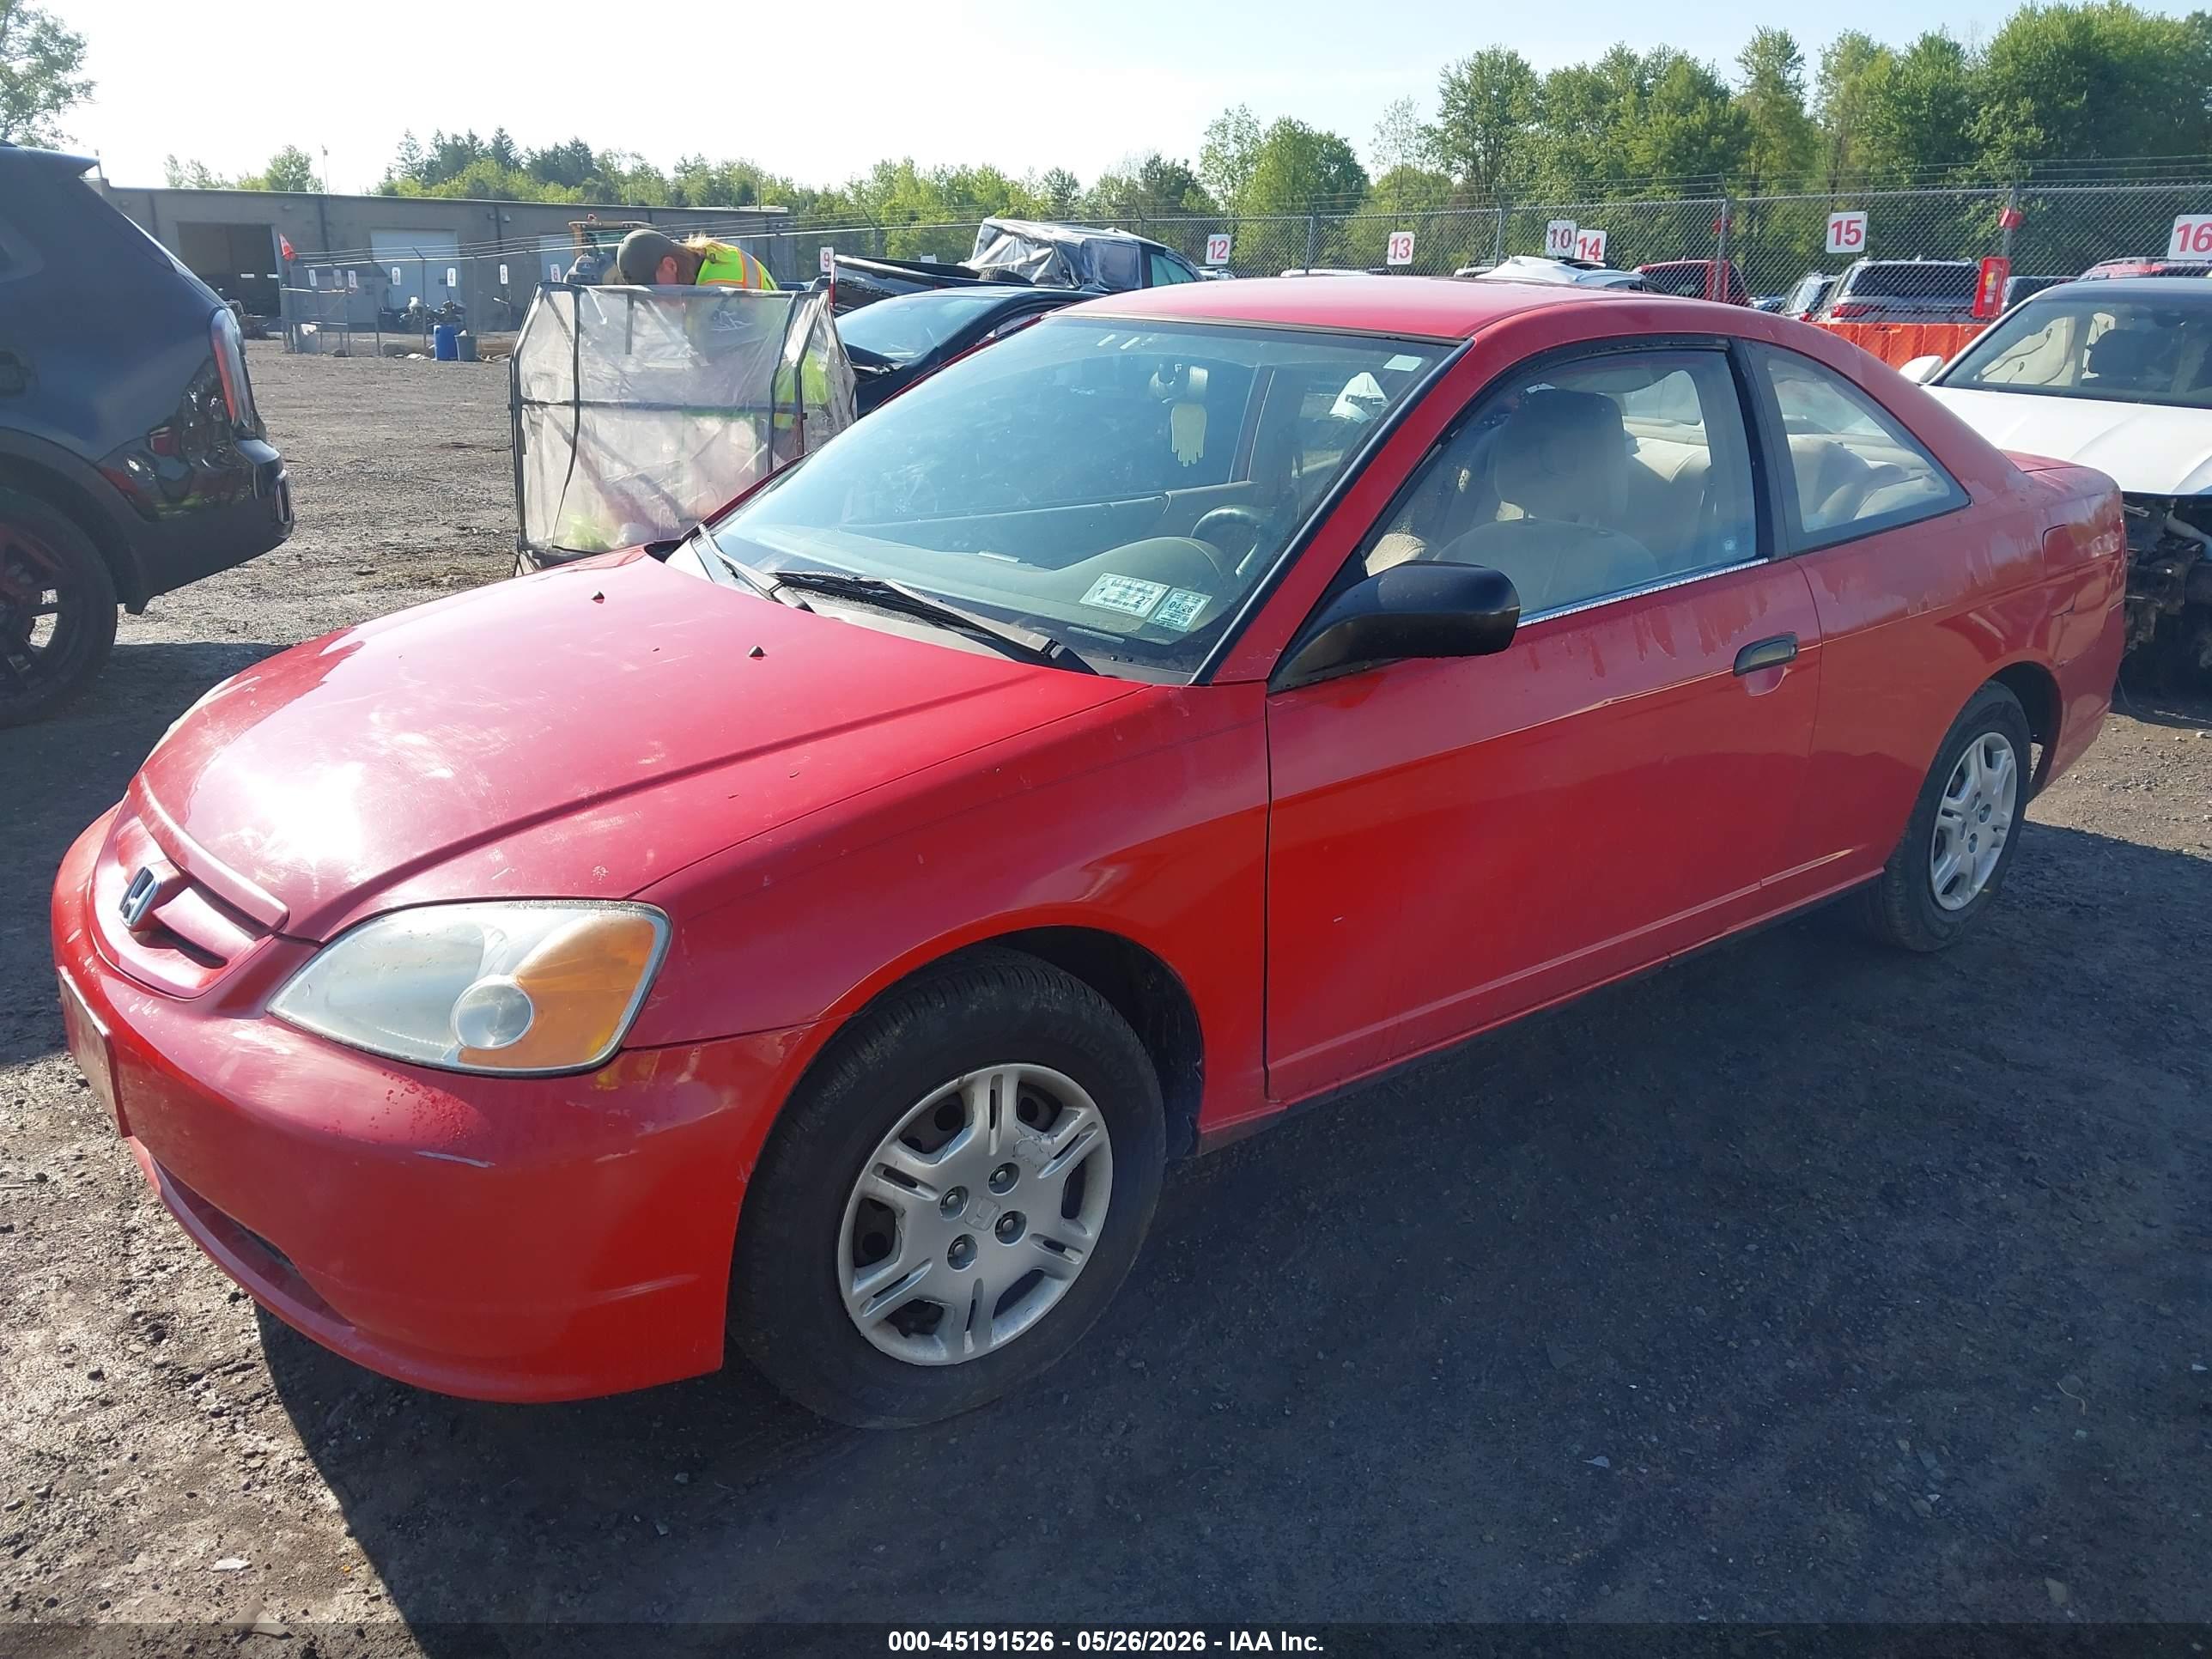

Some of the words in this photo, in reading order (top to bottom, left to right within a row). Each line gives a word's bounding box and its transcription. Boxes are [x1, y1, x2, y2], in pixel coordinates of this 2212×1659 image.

[1551, 228, 1572, 249] 10
[1831, 219, 1863, 246] 15
[2176, 222, 2212, 252] 16
[1208, 240, 1228, 259] 12
[1390, 237, 1411, 259] 13
[1578, 236, 1601, 261] 14
[823, 252, 830, 268] 9
[553, 268, 559, 281] 6
[1135, 596, 1153, 606] 27
